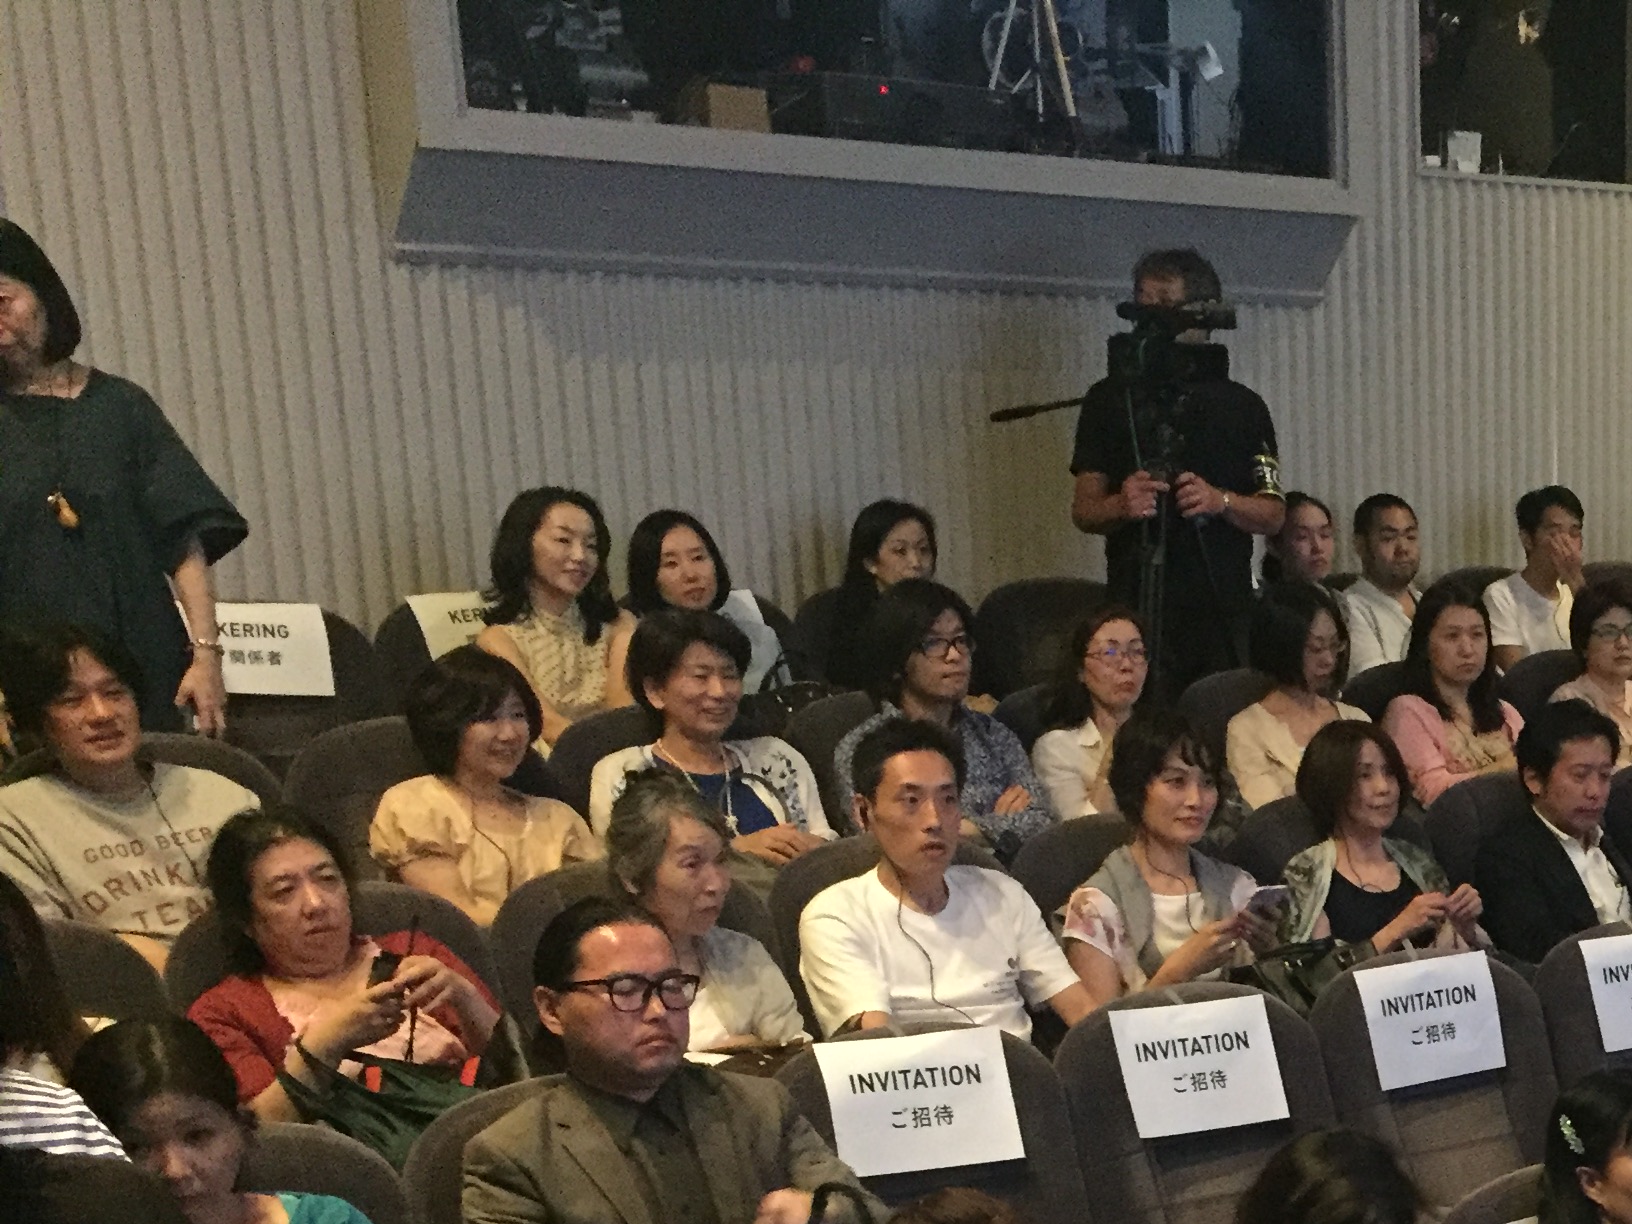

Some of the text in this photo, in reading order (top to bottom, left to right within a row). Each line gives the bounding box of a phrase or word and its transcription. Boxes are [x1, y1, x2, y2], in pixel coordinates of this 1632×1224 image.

[448, 606, 485, 624] KER
[218, 621, 290, 639] KERING
[82, 825, 213, 865] GOOD BEER
[81, 860, 200, 916] DRINK
[1380, 983, 1477, 1018] INVITATION
[1134, 1030, 1251, 1063] INVITATION
[1411, 1021, 1457, 1046] ご招待
[848, 1063, 982, 1095] INVITATION
[1173, 1069, 1228, 1094] ご招待
[891, 1104, 955, 1129] ご招待
